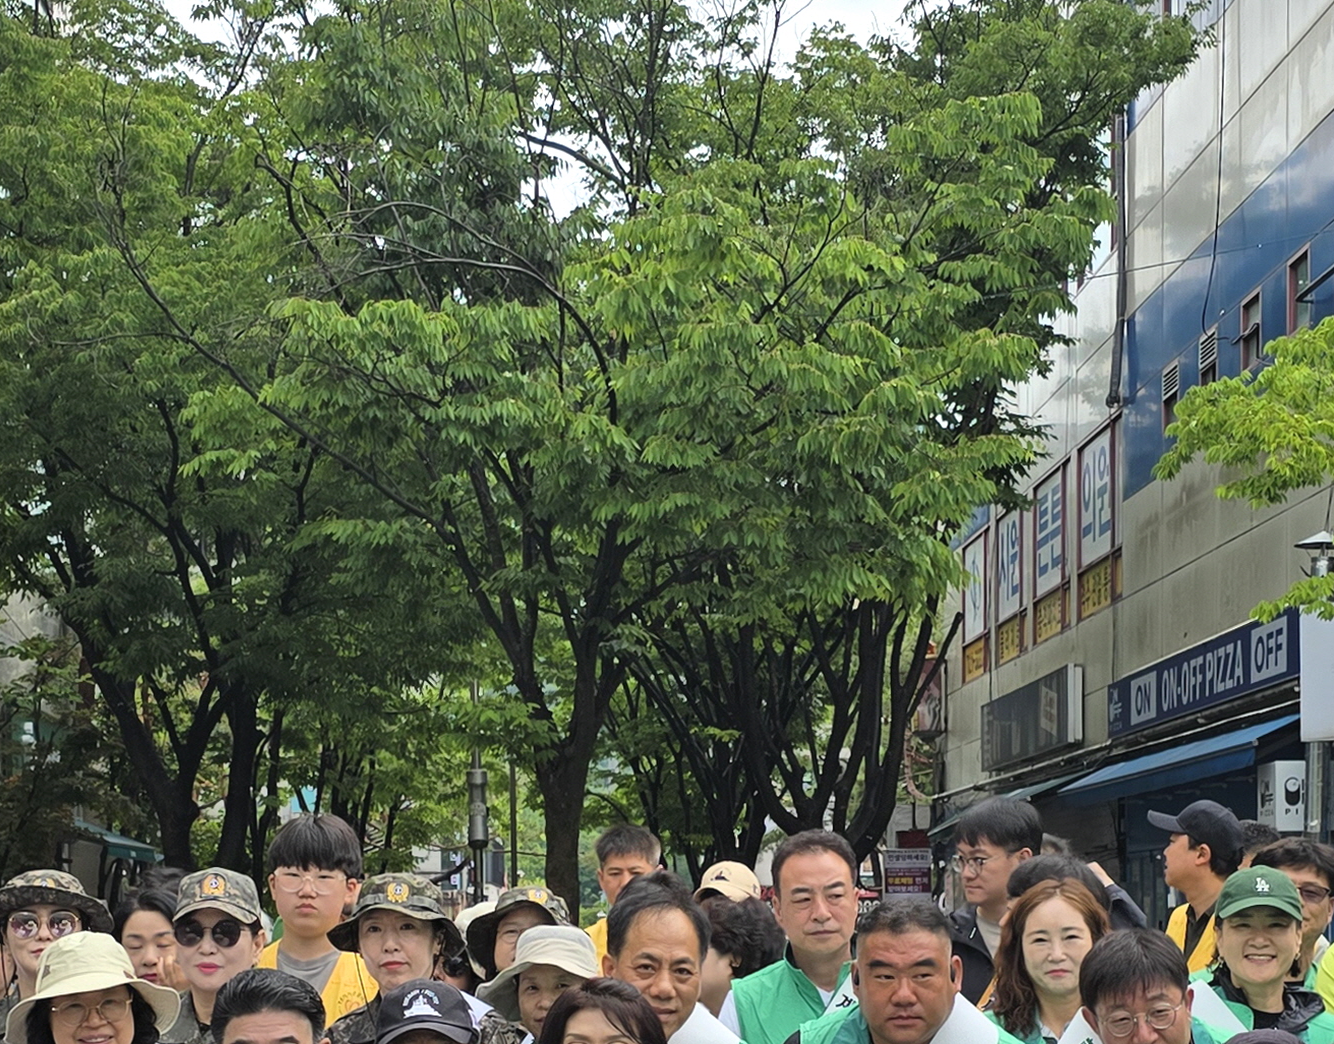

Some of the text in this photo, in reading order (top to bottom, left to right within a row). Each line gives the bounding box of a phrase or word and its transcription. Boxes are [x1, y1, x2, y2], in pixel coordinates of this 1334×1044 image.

[1135, 680, 1152, 718] ON
[1205, 639, 1244, 698] PIZZA
[1254, 626, 1284, 675] OFF
[1255, 877, 1270, 892] LA
